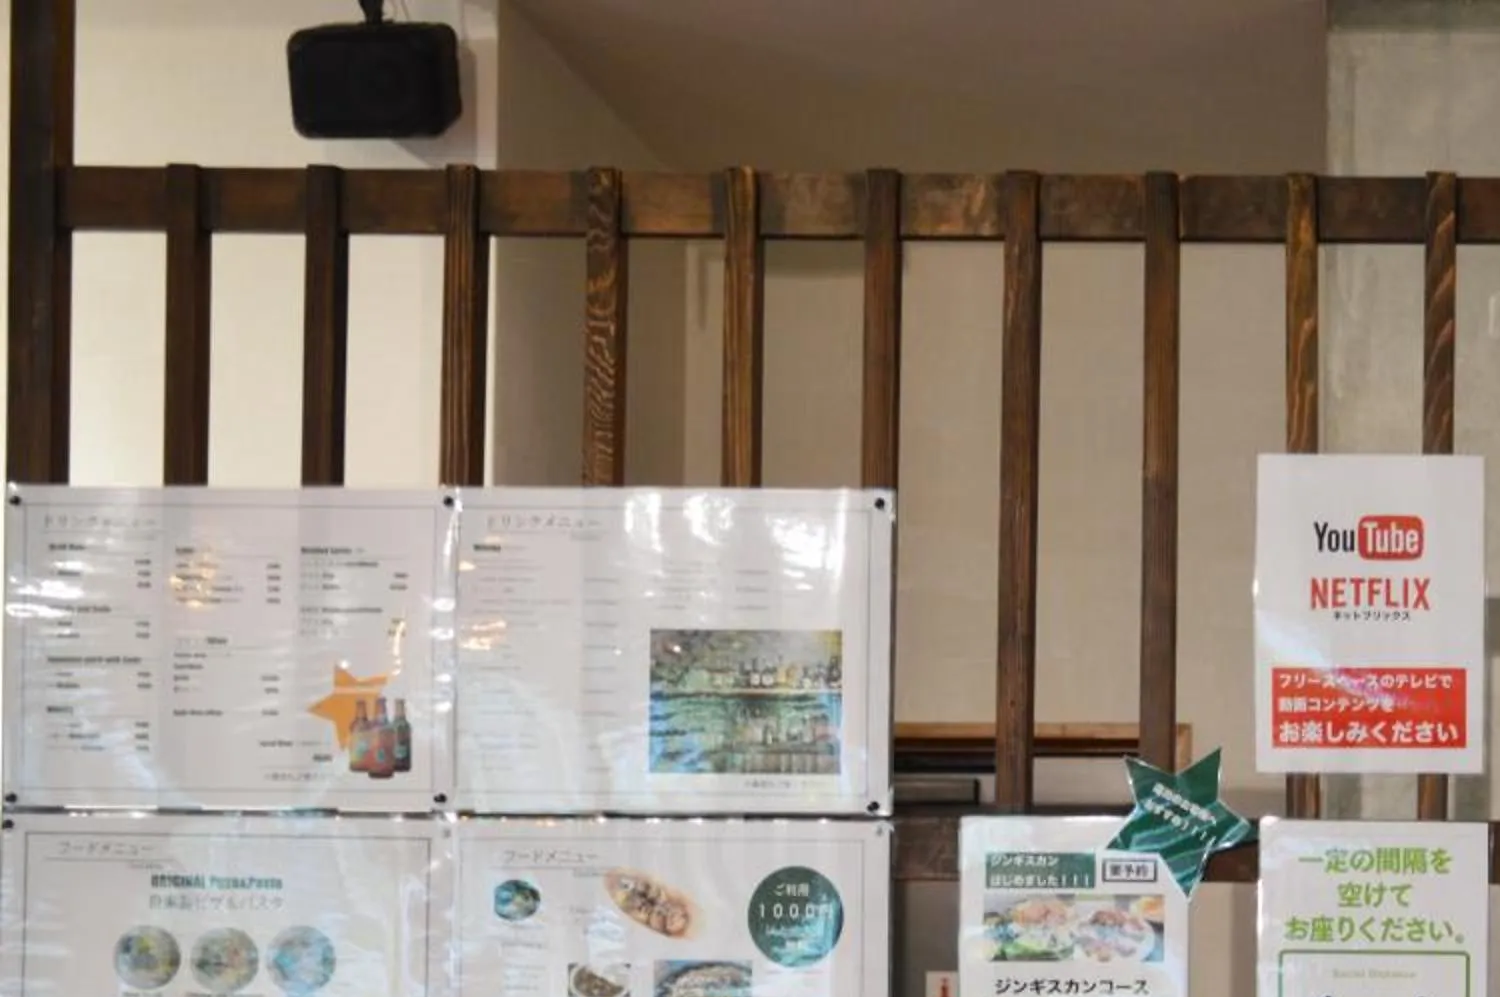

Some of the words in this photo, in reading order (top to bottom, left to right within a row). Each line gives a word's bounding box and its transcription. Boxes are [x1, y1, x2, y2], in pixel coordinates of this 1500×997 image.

[1314, 519, 1422, 556] YouTube
[1310, 577, 1431, 611] NETFLIX
[1279, 721, 1459, 744] お楽しみください
[1298, 847, 1454, 875] 一定の間隔を
[1337, 881, 1414, 908] 空けて
[1284, 916, 1466, 944] お座りください。
[995, 978, 1151, 996] ジンギスカンコース
